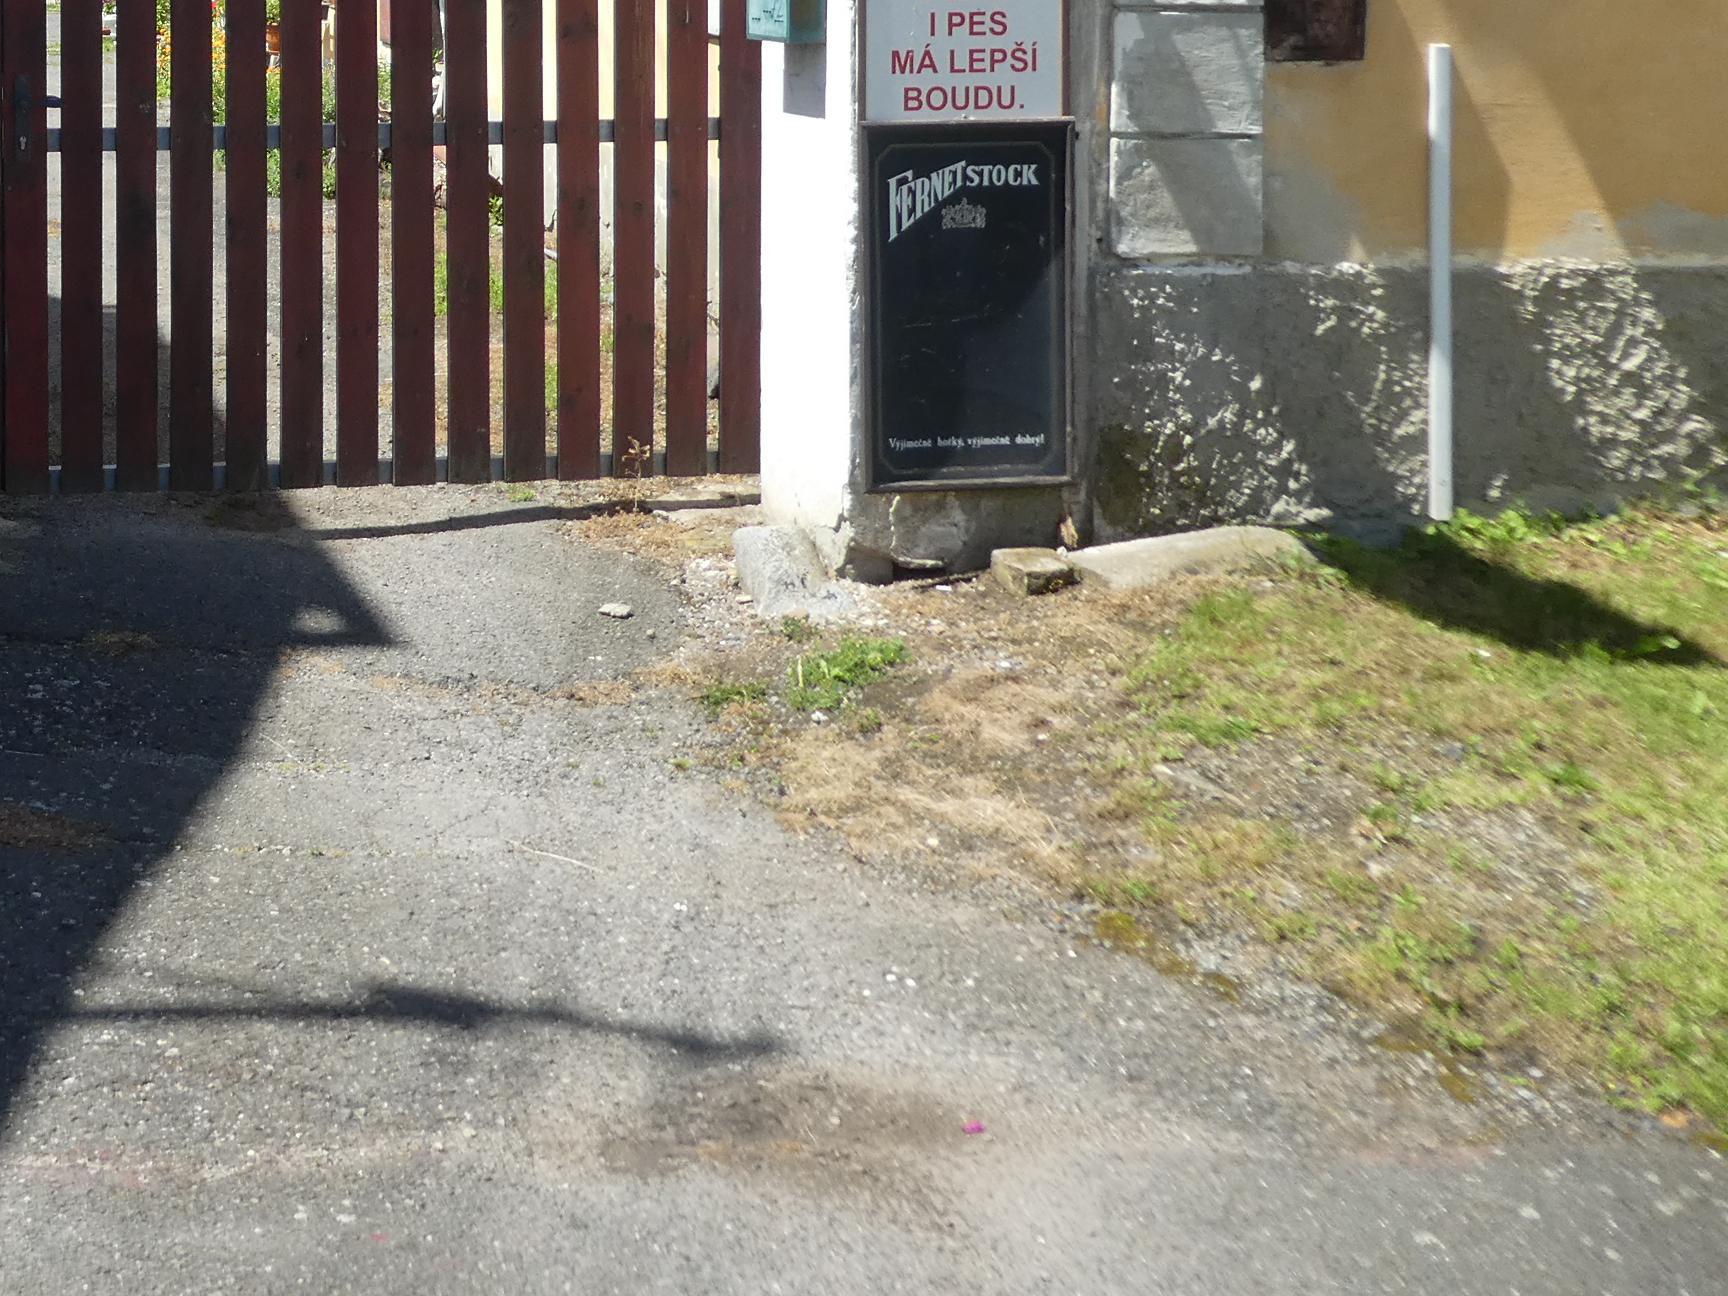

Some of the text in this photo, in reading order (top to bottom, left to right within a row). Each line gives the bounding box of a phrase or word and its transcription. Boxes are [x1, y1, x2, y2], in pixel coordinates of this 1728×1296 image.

[930, 11, 1008, 37] I PES
[891, 41, 1037, 75] MÁ LEPŠÍ
[903, 85, 1024, 111] BOUDU.
[887, 160, 1040, 243] FERNET STOCK
